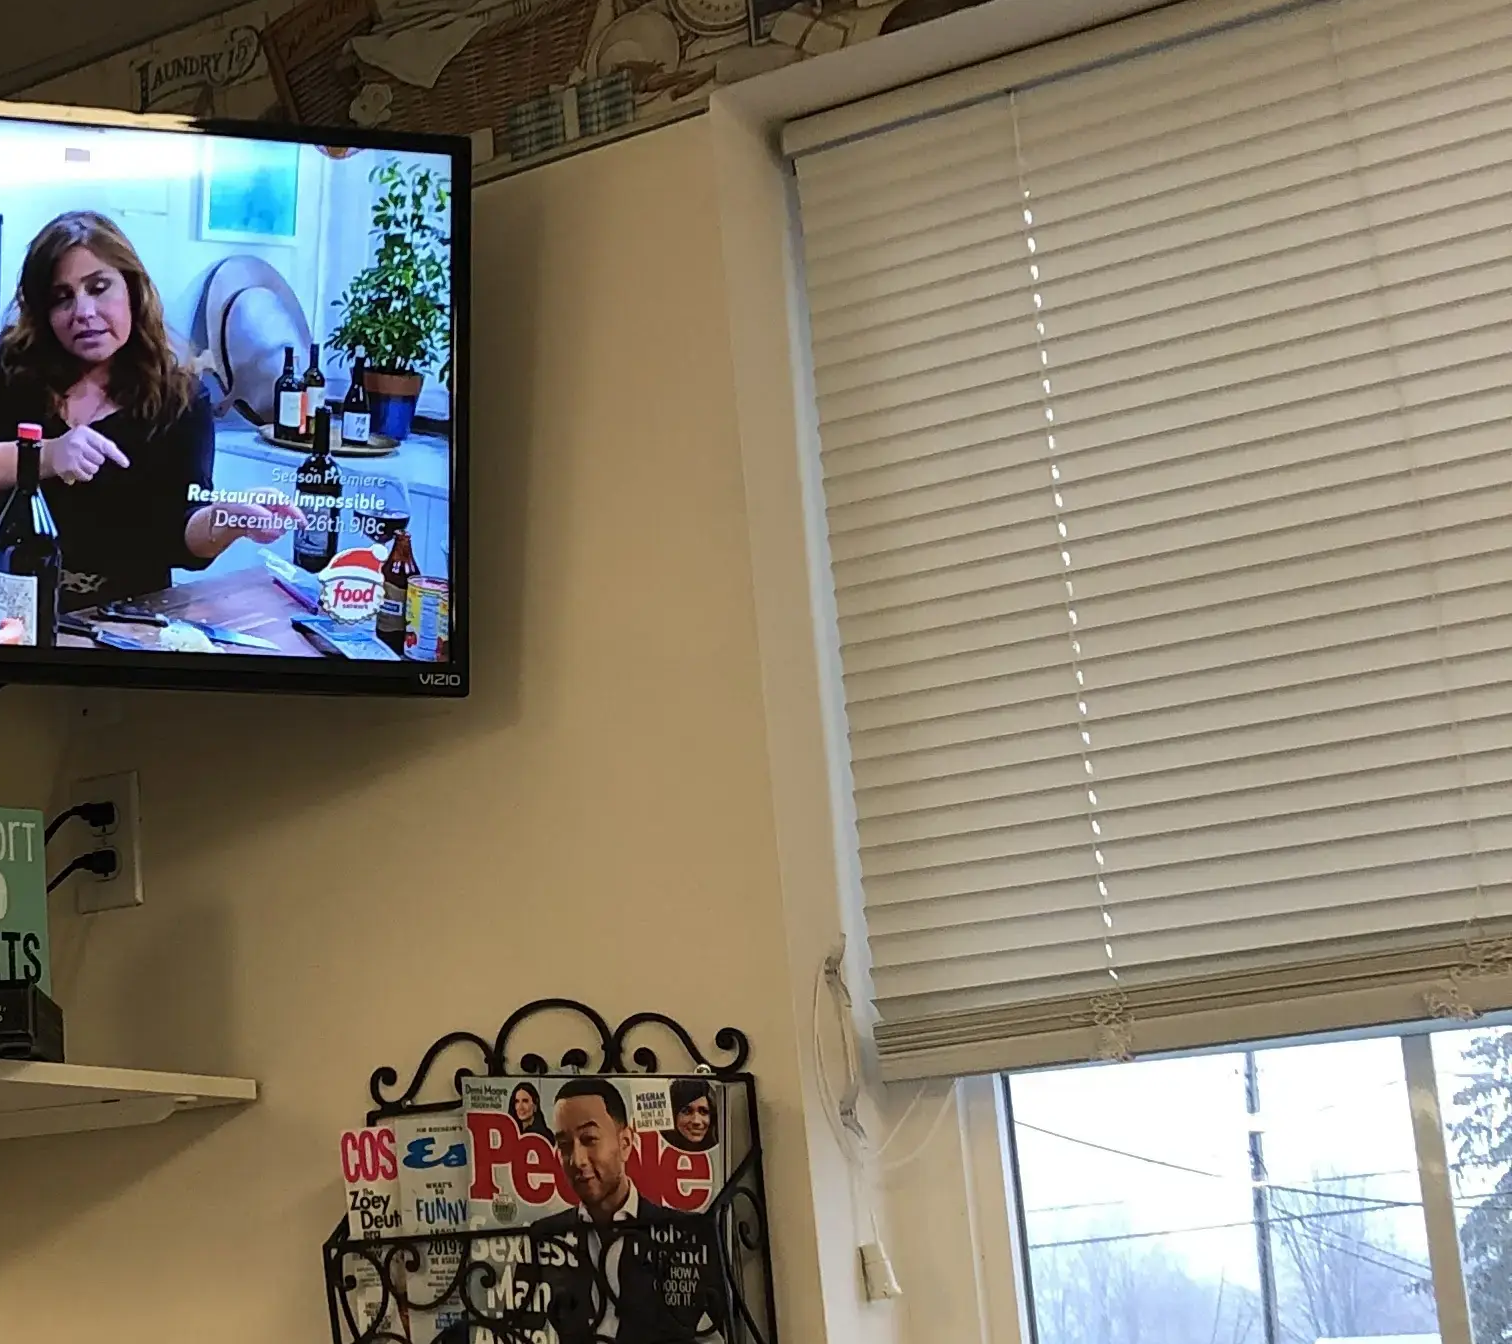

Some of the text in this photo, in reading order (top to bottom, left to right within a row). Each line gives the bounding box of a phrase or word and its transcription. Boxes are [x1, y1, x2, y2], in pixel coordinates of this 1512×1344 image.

[135, 53, 224, 114] LAUNDRY
[271, 467, 386, 488] Season Premiere
[294, 492, 386, 512] Impossible
[214, 508, 300, 531] December
[304, 513, 344, 532] 26th
[332, 580, 376, 606] food
[418, 672, 461, 687] VIZIO
[341, 1129, 398, 1183] COS
[349, 1190, 391, 1215] Zoey
[415, 1197, 467, 1226] FUNNY
[670, 1266, 691, 1280] HOW
[488, 1264, 551, 1313] Man
[678, 1280, 698, 1294] GUY
[664, 1292, 681, 1307] GOT
